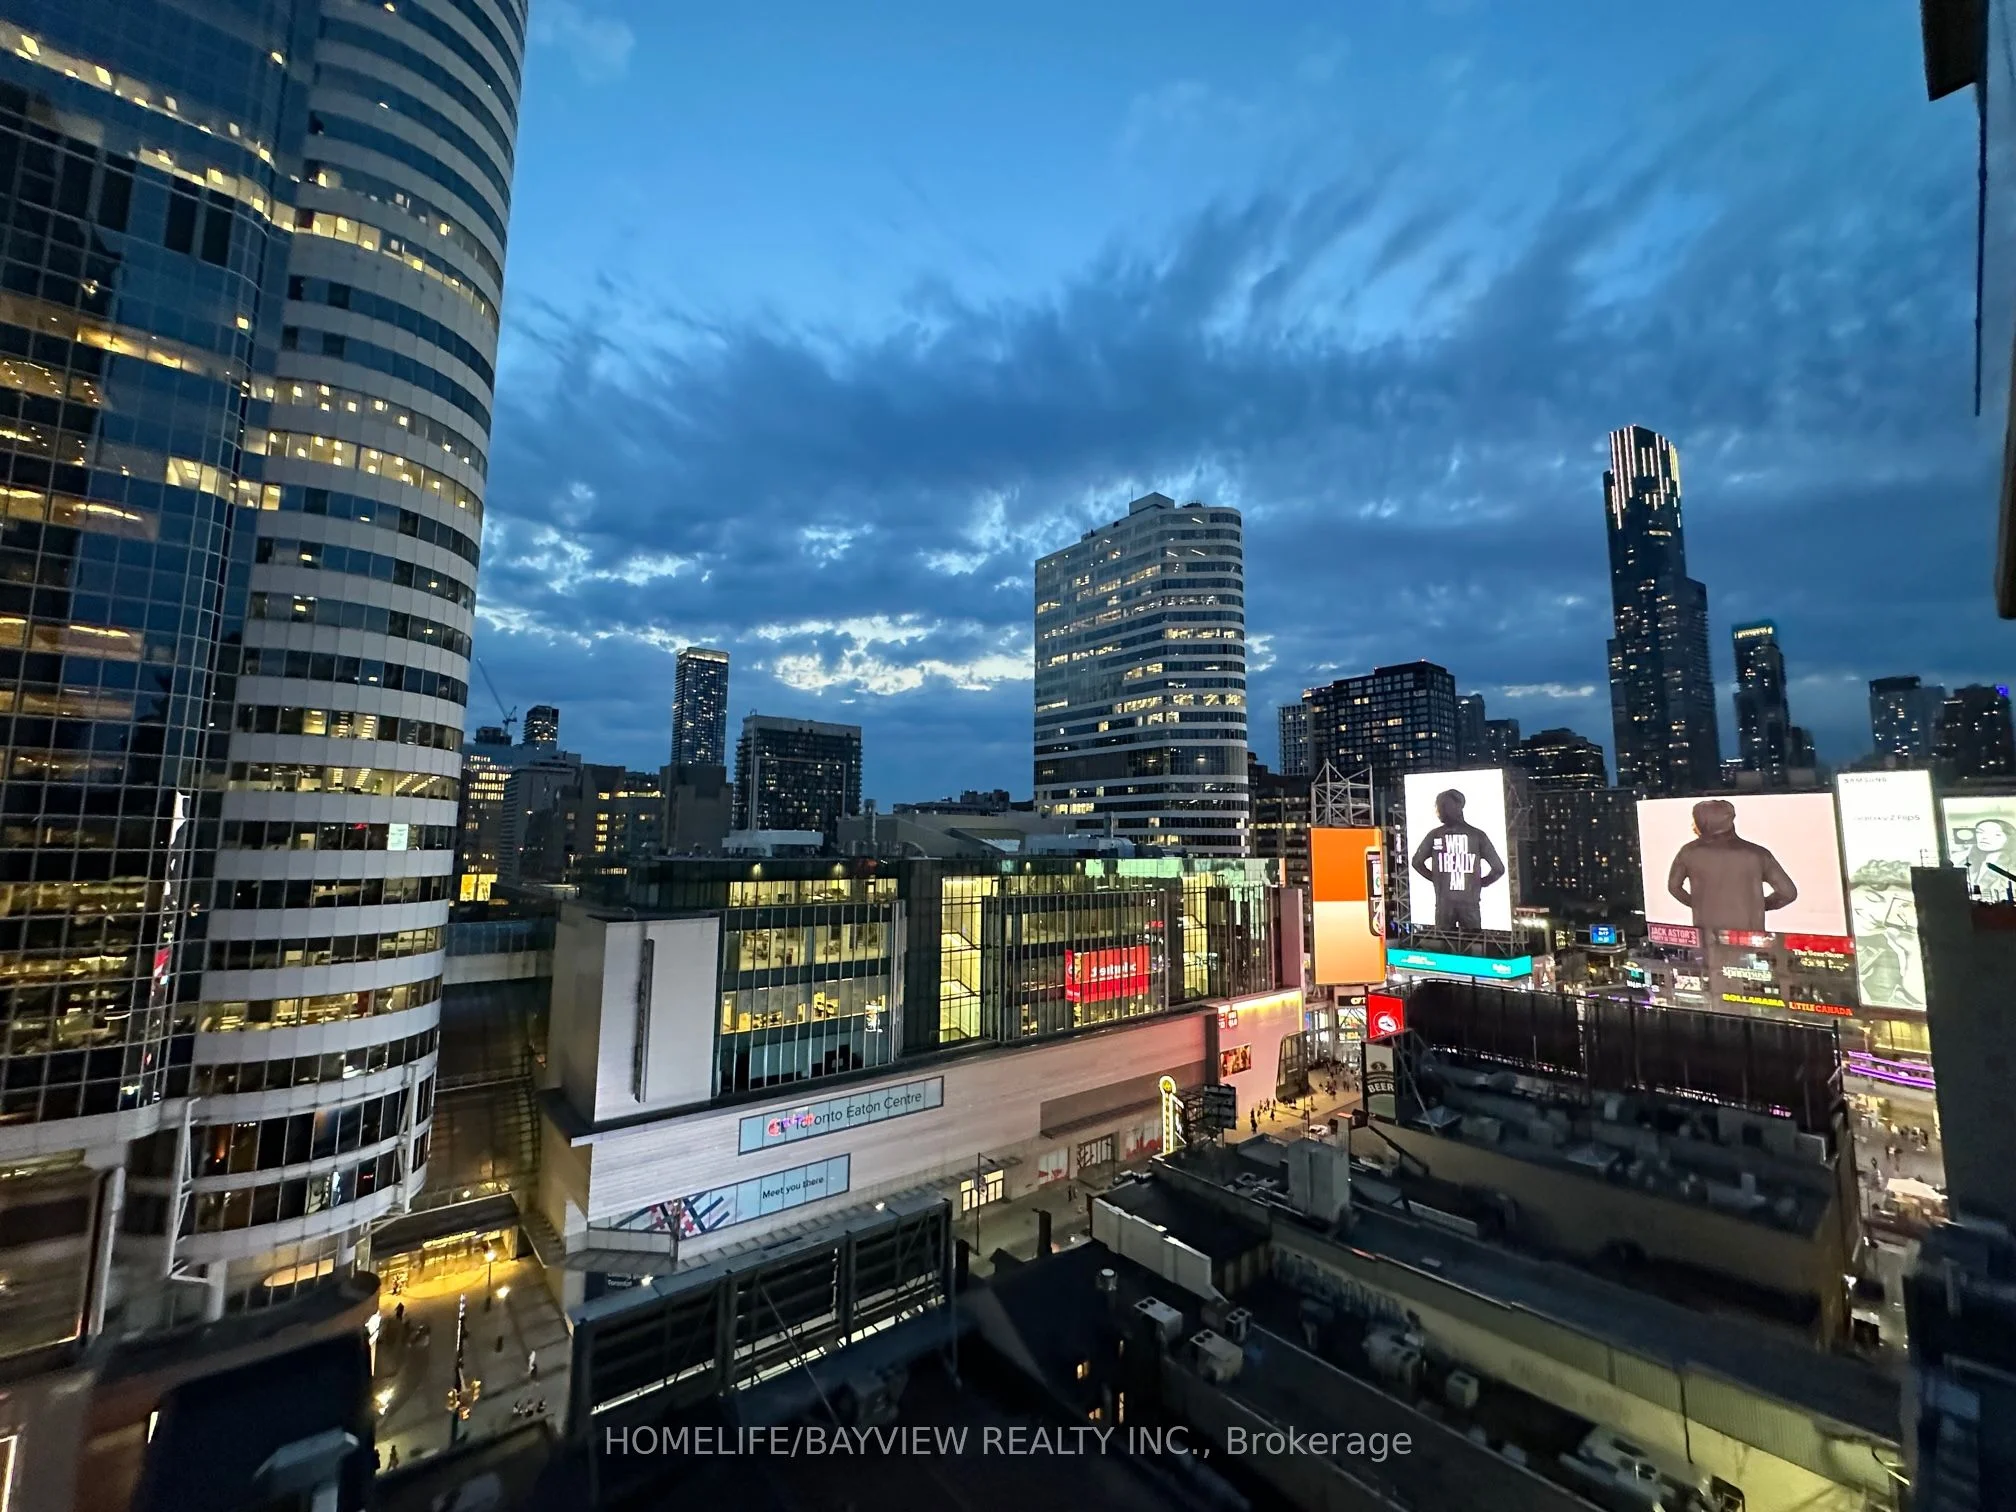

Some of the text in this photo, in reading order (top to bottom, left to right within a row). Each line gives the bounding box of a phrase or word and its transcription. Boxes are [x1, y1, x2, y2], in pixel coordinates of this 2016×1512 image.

[1445, 834, 1468, 853] WHO
[1443, 852, 1476, 873] REALLY
[1449, 872, 1466, 891] AM
[1651, 926, 1697, 940] JACK ASTOR'S
[1789, 1001, 1854, 1016] LITTLE CANADA
[1367, 1082, 1395, 1094] BEER
[795, 1110, 843, 1130] Toronto
[847, 1100, 881, 1118] Eaton
[884, 1091, 923, 1109] Centre
[762, 1176, 824, 1199] Meet you there
